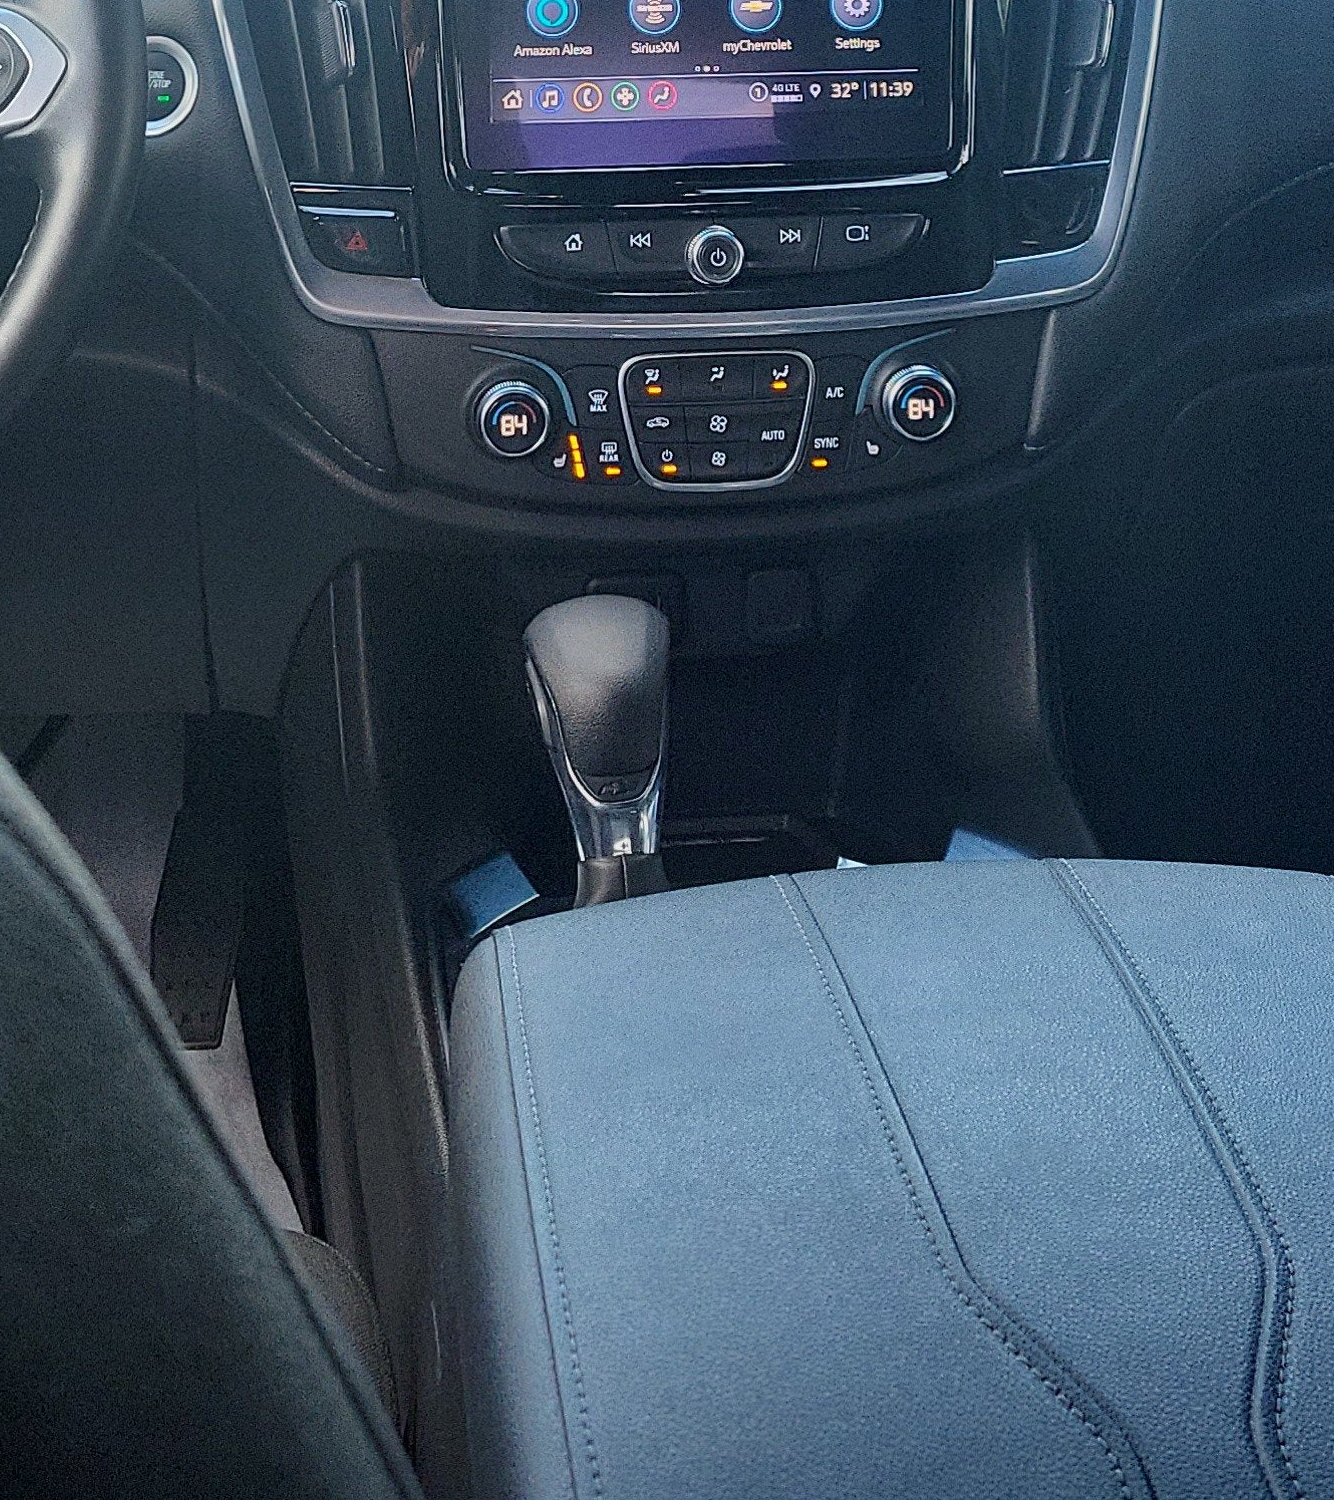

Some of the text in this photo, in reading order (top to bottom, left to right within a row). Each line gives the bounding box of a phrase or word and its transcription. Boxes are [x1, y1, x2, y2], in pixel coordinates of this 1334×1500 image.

[513, 43, 593, 58] Amazon Alexa
[631, 41, 680, 55] SiriusXM
[723, 38, 793, 55] myChevrolet
[835, 37, 881, 52] Settings
[771, 83, 800, 92] 4G LTE
[870, 81, 914, 98] 11:39
[825, 386, 845, 399] A/C
[589, 403, 608, 412] MAX
[907, 398, 935, 421] 84
[500, 414, 528, 437] 84
[761, 429, 786, 441] AUTO
[814, 437, 839, 449] SYNC
[599, 454, 619, 463] REAR
